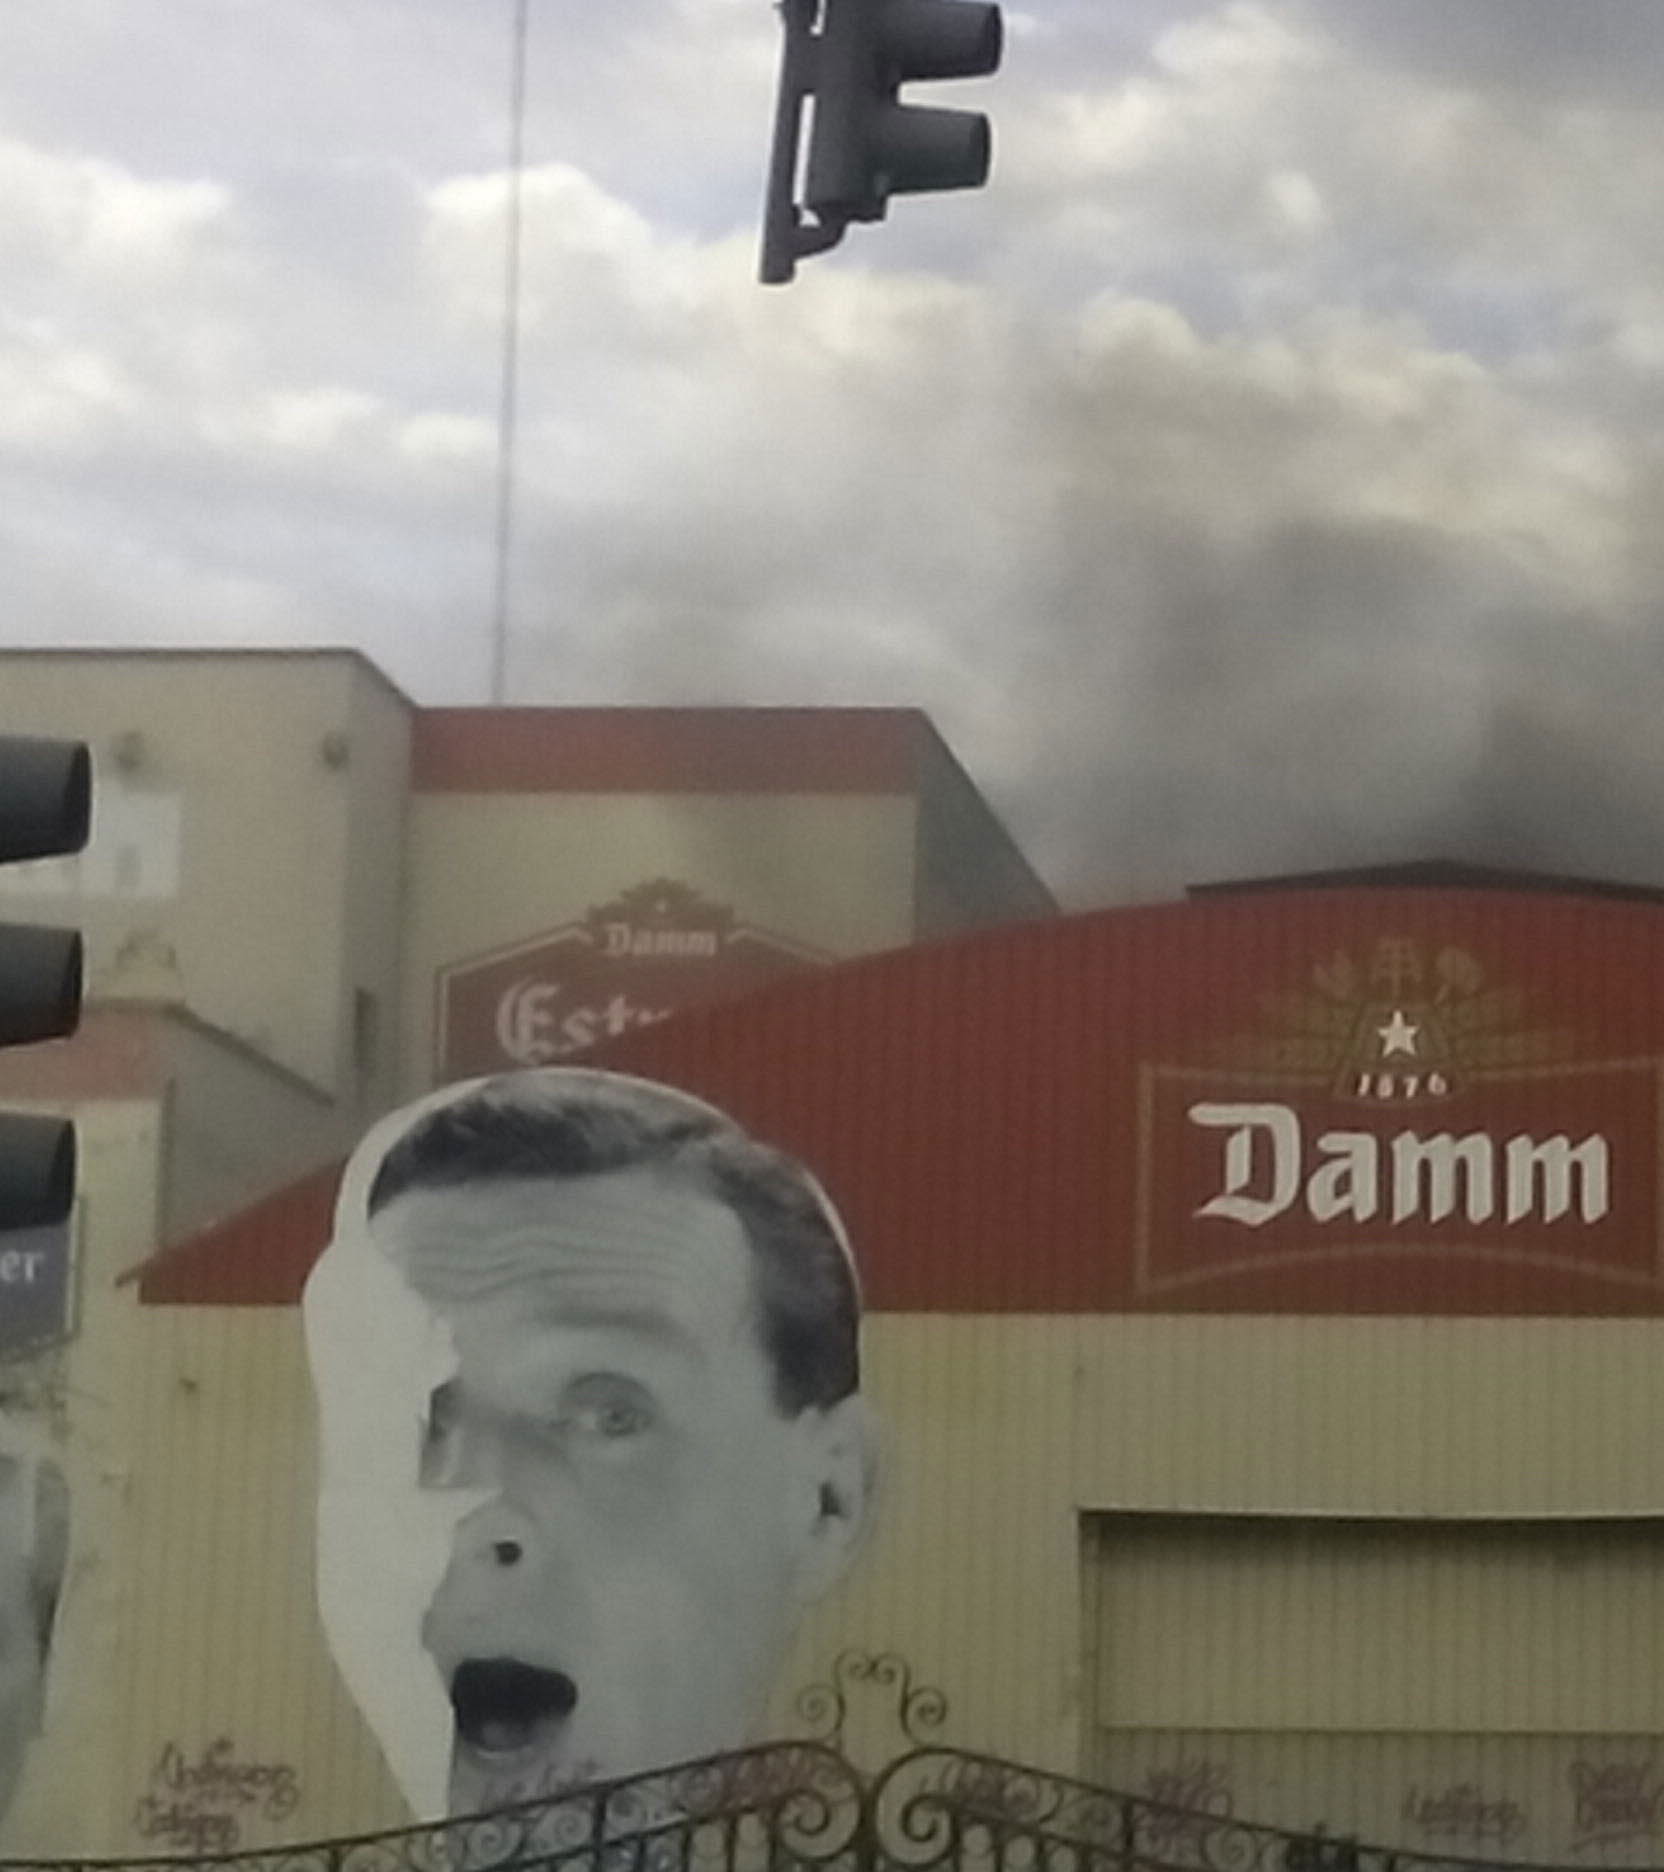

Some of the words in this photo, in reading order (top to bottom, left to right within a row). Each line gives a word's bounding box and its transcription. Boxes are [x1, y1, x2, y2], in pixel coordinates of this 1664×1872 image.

[604, 922, 717, 956] Damm
[1356, 1073, 1448, 1099] 1876
[1188, 1103, 1608, 1229] Damm
